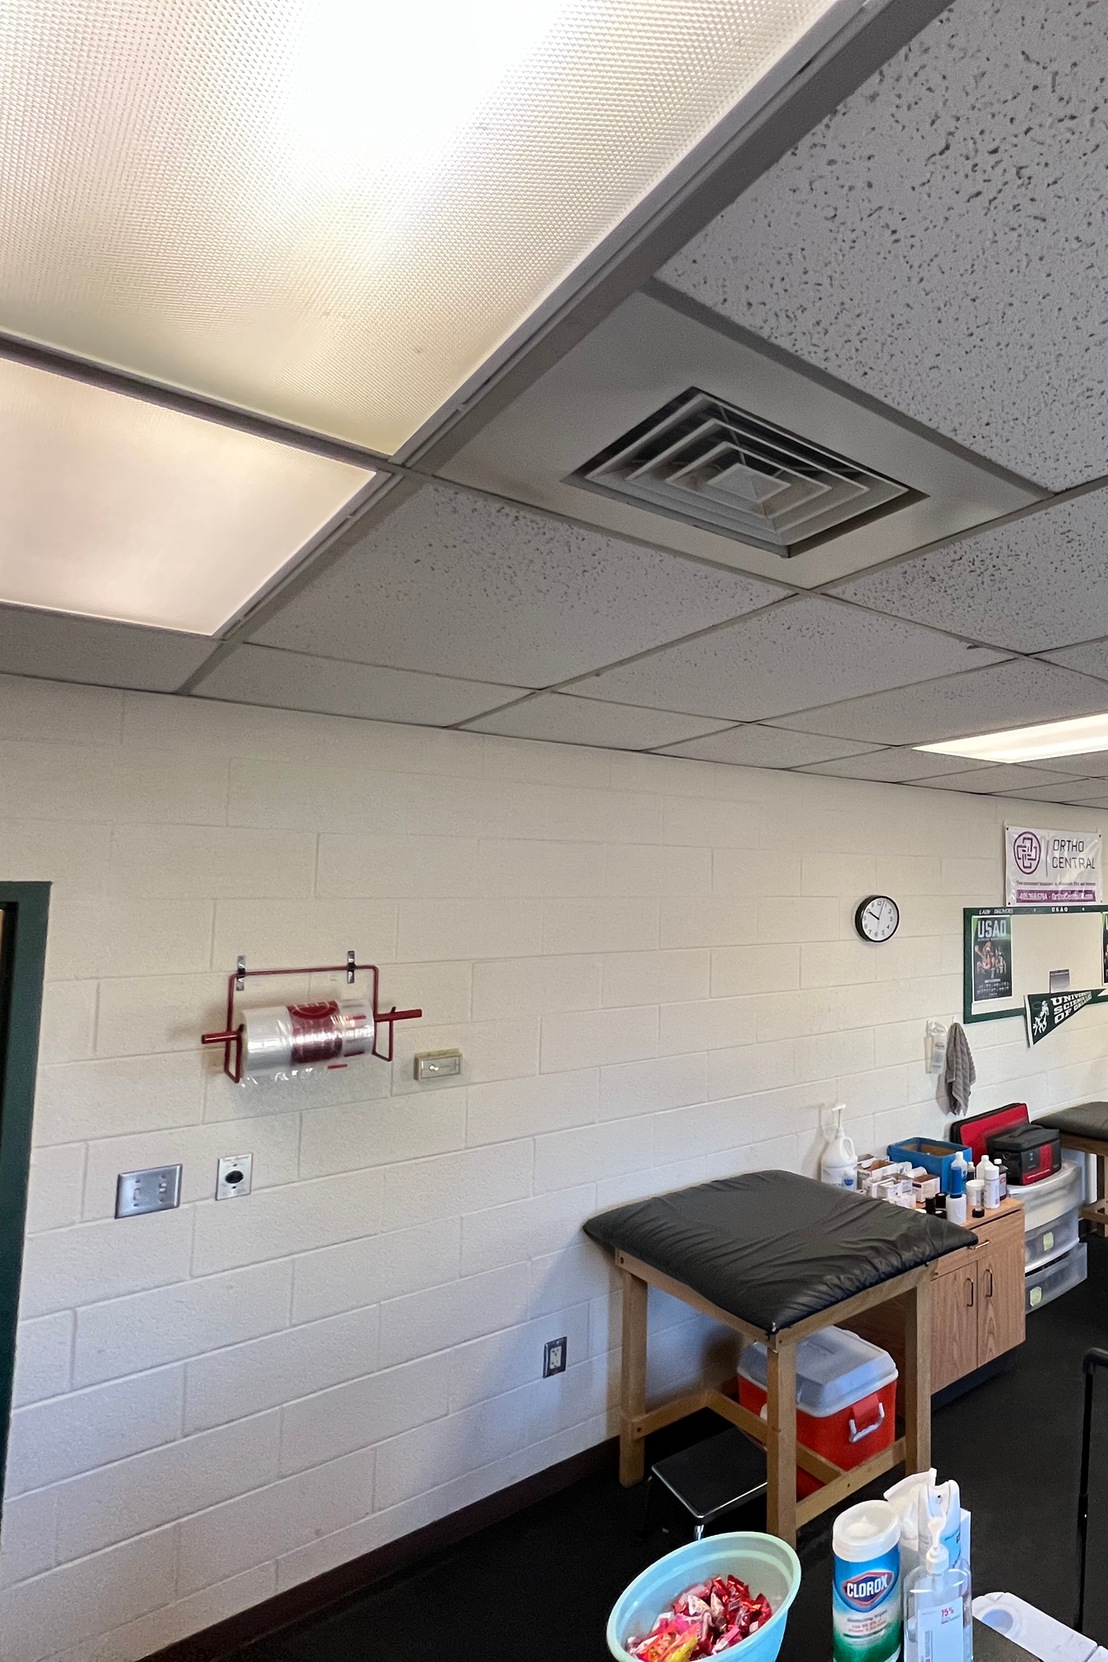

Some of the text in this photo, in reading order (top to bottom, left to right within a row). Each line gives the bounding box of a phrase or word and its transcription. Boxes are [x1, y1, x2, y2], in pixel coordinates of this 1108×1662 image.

[1052, 839, 1085, 853] ORTHO
[1051, 856, 1096, 870] CENTRAL
[977, 920, 1007, 938] USAO
[1054, 1008, 1072, 1024] OF
[846, 1574, 888, 1598] CLOROX
